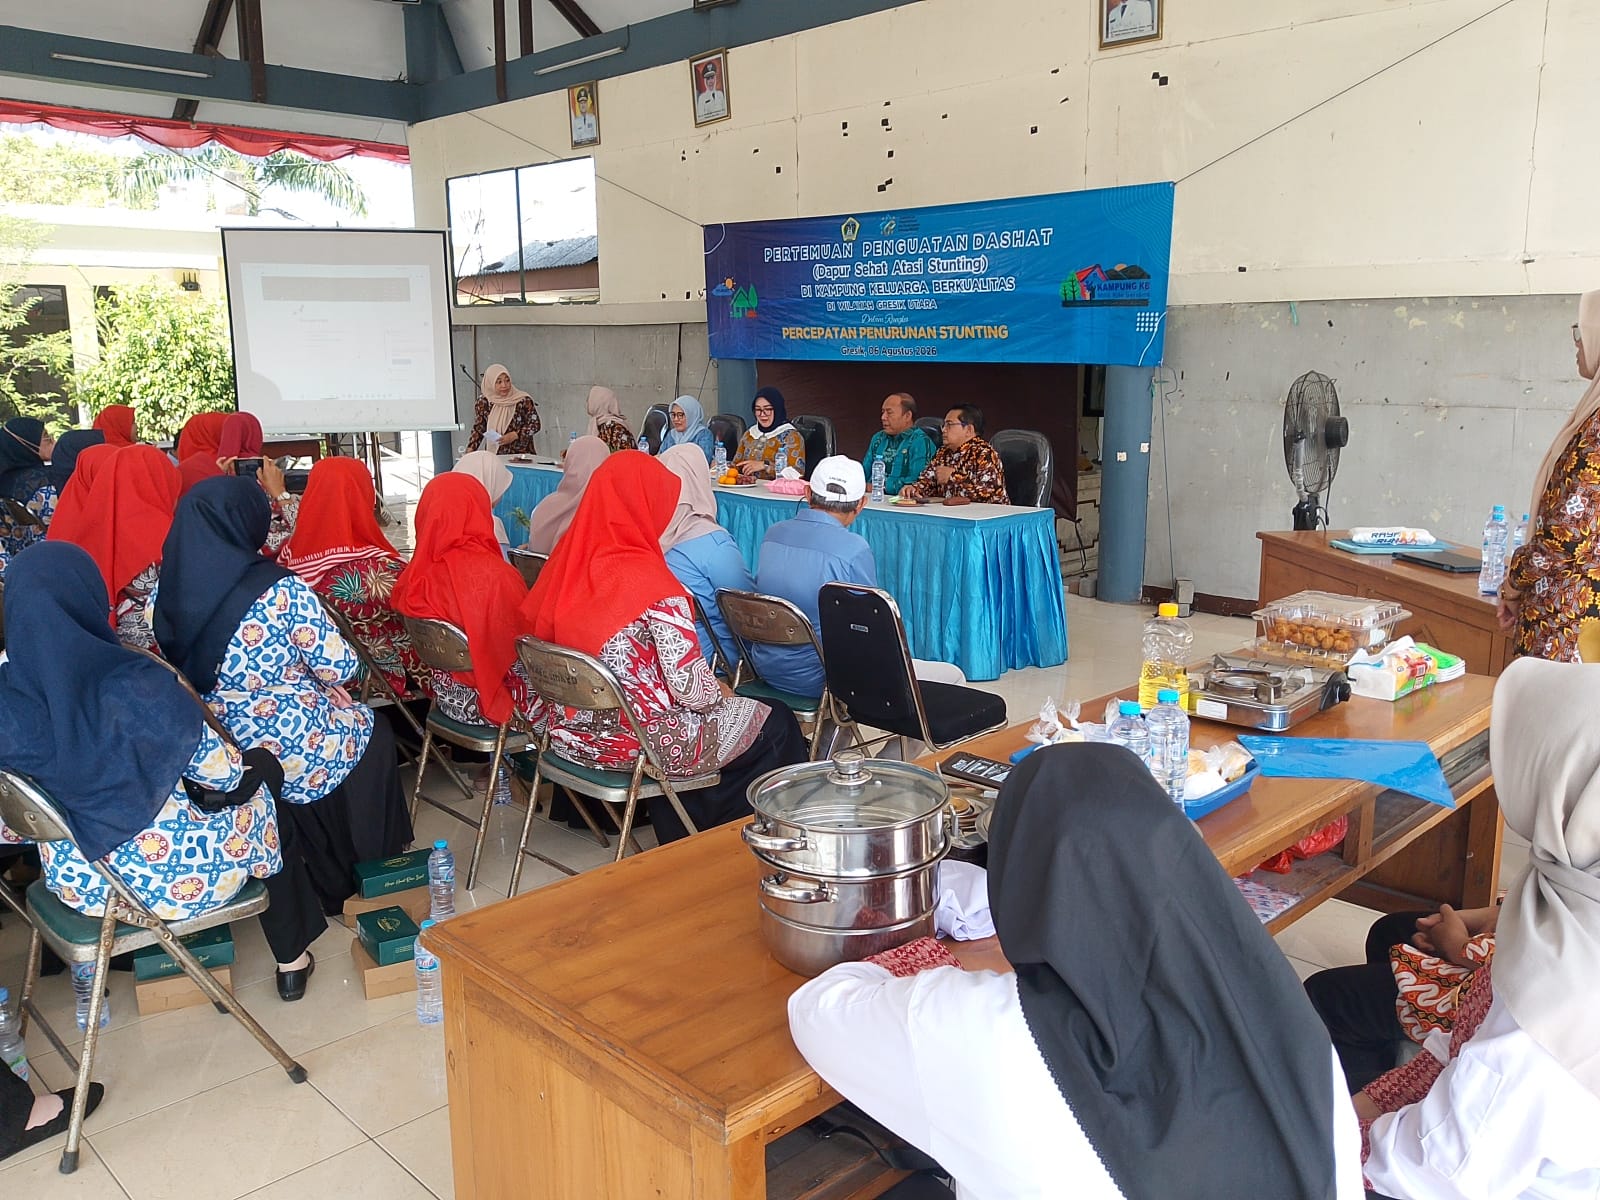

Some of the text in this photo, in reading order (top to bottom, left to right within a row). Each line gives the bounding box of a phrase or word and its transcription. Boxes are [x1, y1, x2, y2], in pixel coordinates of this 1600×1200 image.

[764, 228, 1053, 262] PERTEMUAN PENGUATAN DASHAT
[812, 254, 989, 281] (Dapur Sehat Atasi Stunting)
[801, 276, 1016, 298] DI KAMPUNG KELUARGA BERKUALITAS
[1096, 282, 1137, 292] KAMPUNG
[826, 301, 836, 312] DI
[876, 299, 907, 311] GRESIK
[908, 298, 938, 310] UTARA
[781, 324, 1009, 340] PERCEPATAN PENURUNAN STUNTING
[841, 345, 938, 358] Gresik, 06 Agustus 2026
